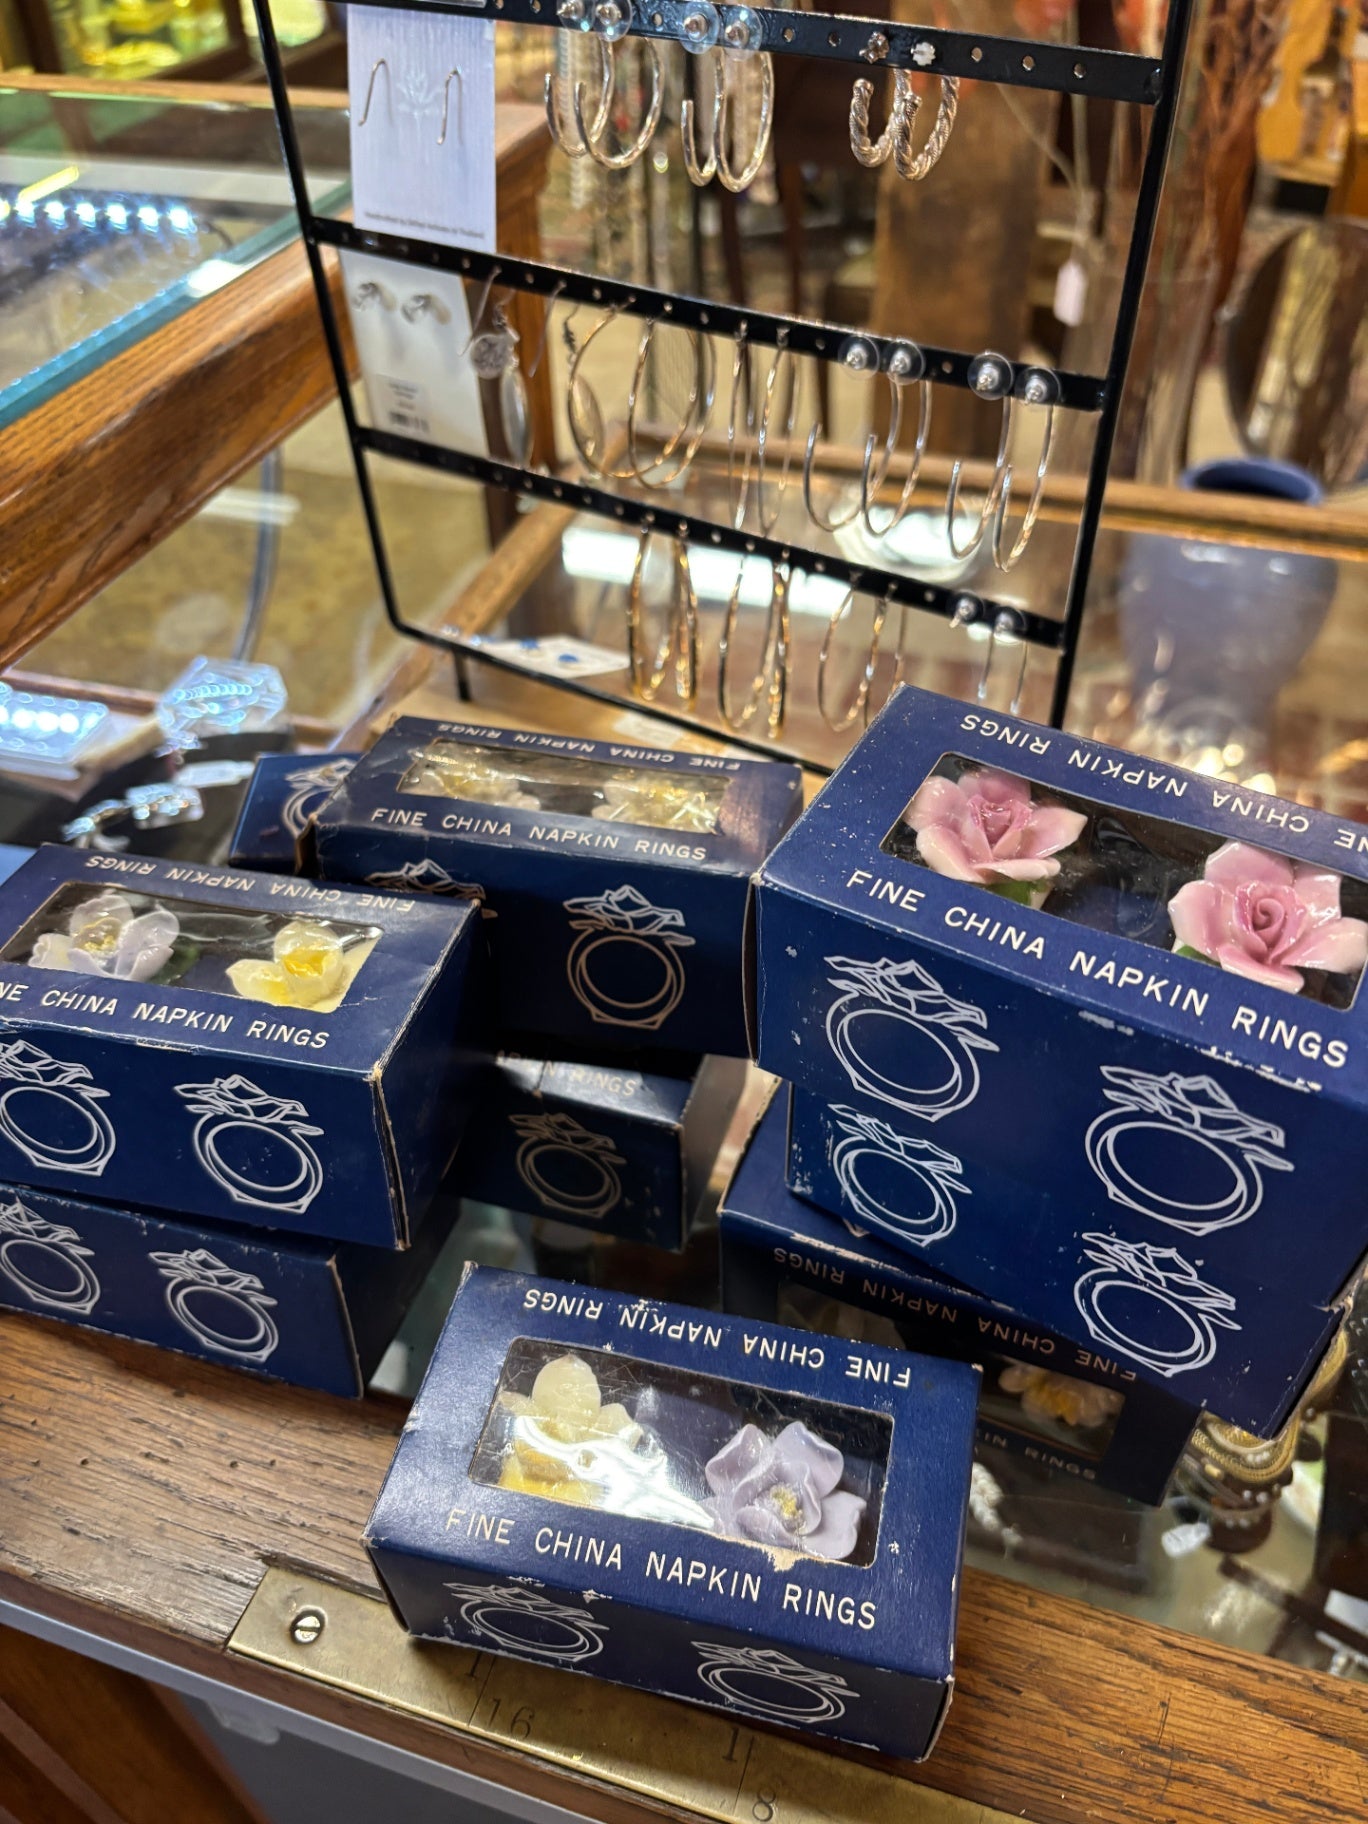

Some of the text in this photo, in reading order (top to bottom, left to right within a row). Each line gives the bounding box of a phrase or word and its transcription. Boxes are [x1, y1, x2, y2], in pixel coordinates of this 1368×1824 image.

[437, 723, 741, 771] FINE CHINA NAPKIN RINGS
[960, 714, 1310, 833] CHINA NAPKIN RINGS
[371, 808, 707, 861] FINE CHINA NAPKIN RINGS
[85, 855, 416, 912] FINE CHINA NAPKIN RINGS
[846, 869, 1348, 1068] FINE CHINA NAPKIN RINGS
[0, 981, 330, 1049] NE CHINA NAPKIN RINGS
[572, 1067, 637, 1097] RINGS
[523, 1288, 911, 1388] FINE CHINA NAPKIN RINGS
[773, 1247, 1137, 1382] FINE CHINA NAPKIN RINGS
[446, 1507, 876, 1630] FINE CHINA NAPKIN RINGS
